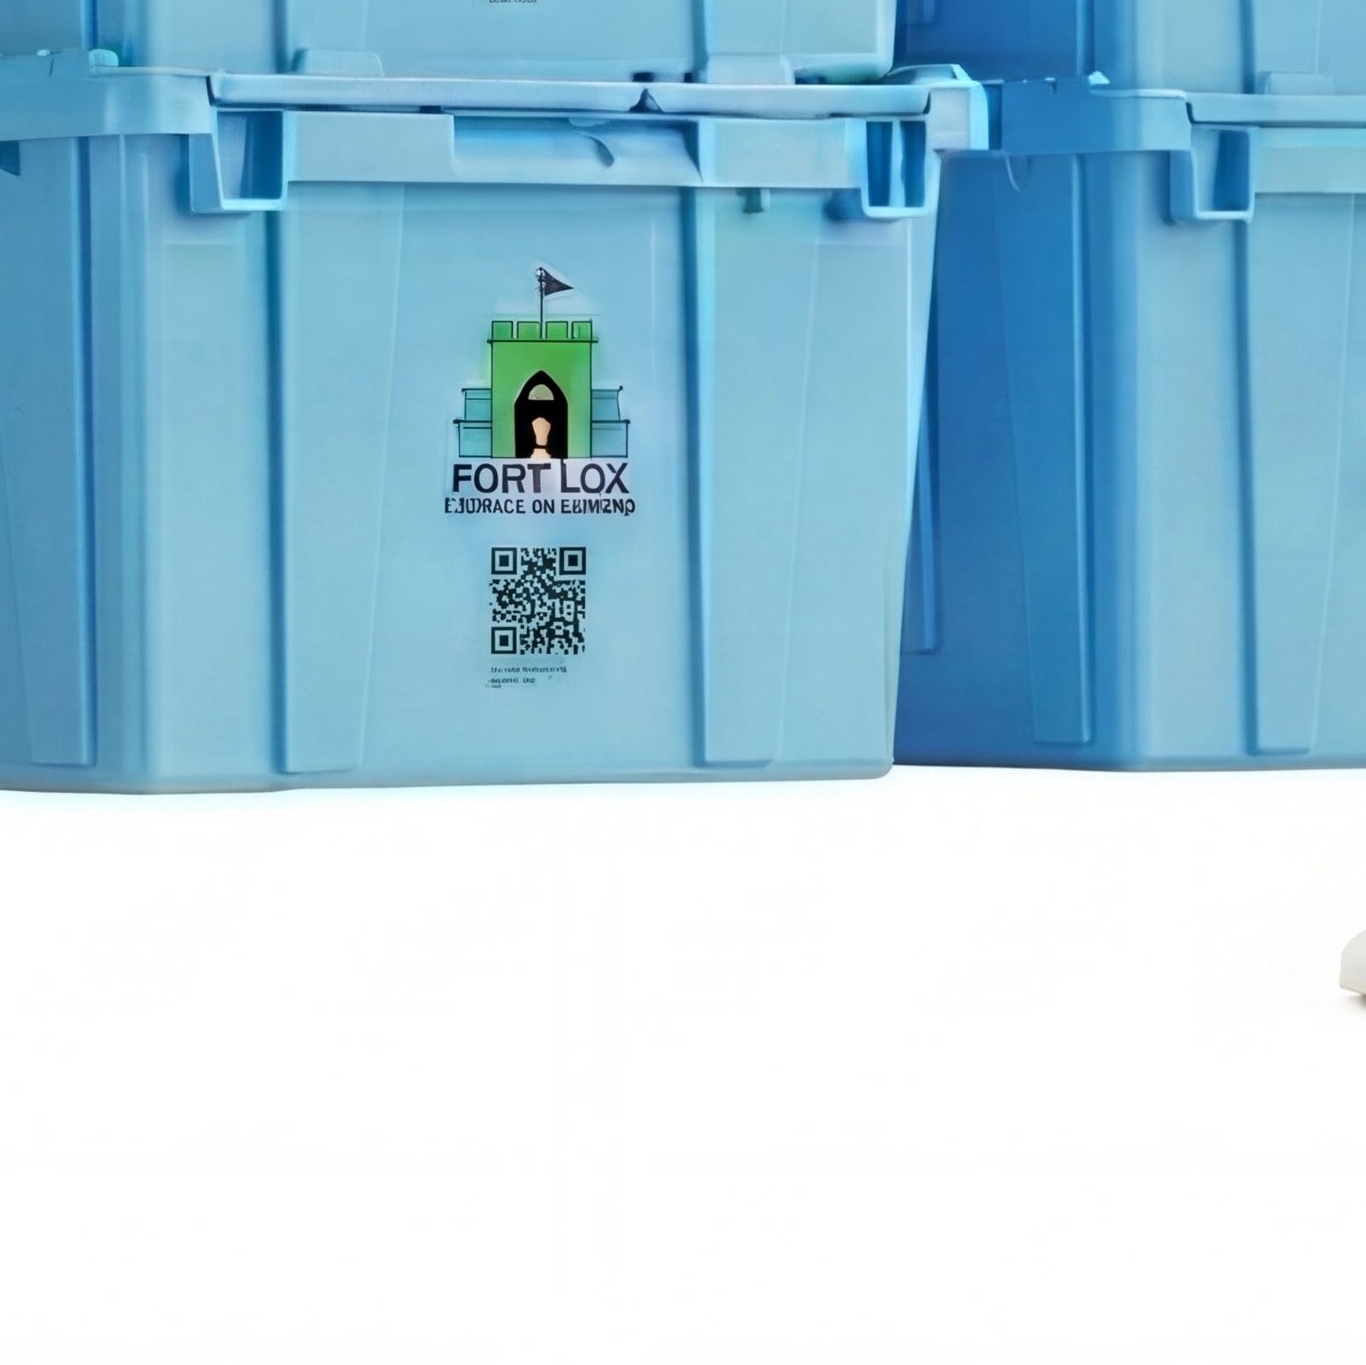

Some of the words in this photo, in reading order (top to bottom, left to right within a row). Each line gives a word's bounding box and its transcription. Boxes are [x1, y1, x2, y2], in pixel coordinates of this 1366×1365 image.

[452, 463, 551, 493] FORT
[560, 461, 630, 494] LOX
[532, 499, 555, 514] ON
